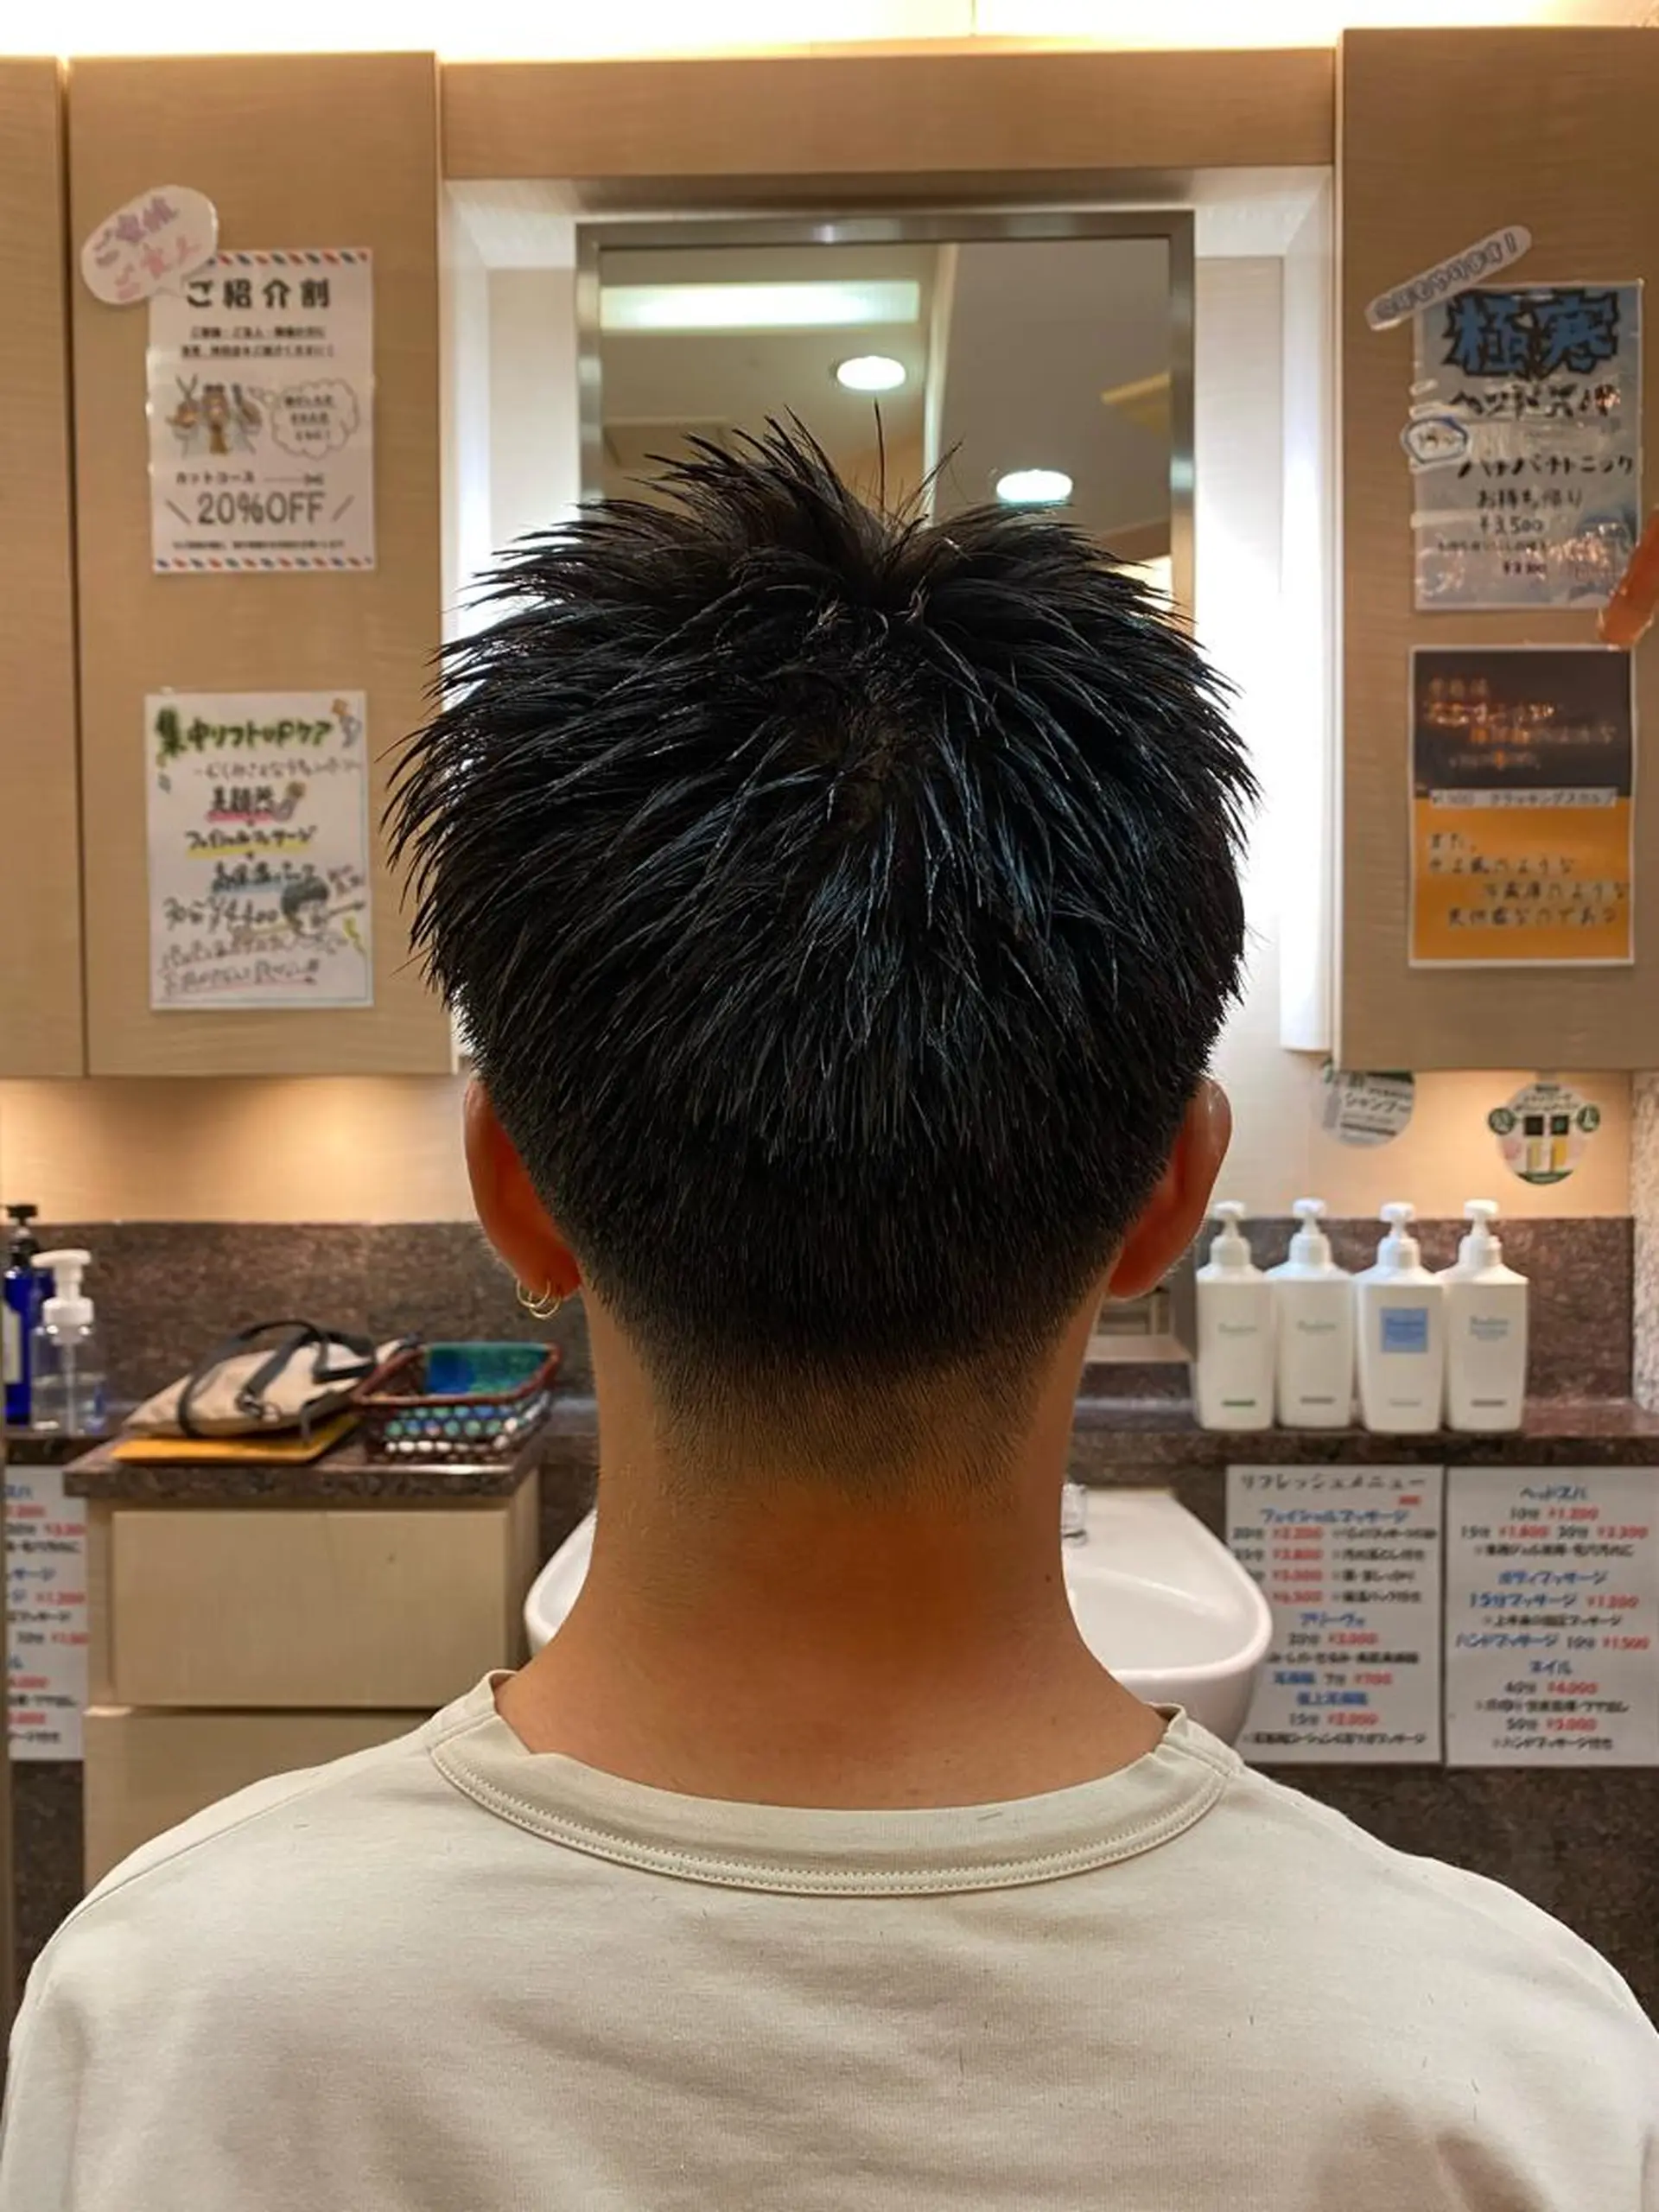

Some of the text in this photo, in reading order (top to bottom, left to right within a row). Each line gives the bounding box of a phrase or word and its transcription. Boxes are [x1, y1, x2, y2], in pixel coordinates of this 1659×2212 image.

[186, 277, 330, 309] ご紹介割
[1442, 289, 1620, 380] 極寒
[196, 492, 326, 525] 20%OFF
[1241, 1473, 1425, 1491] リフレッシュメニュー
